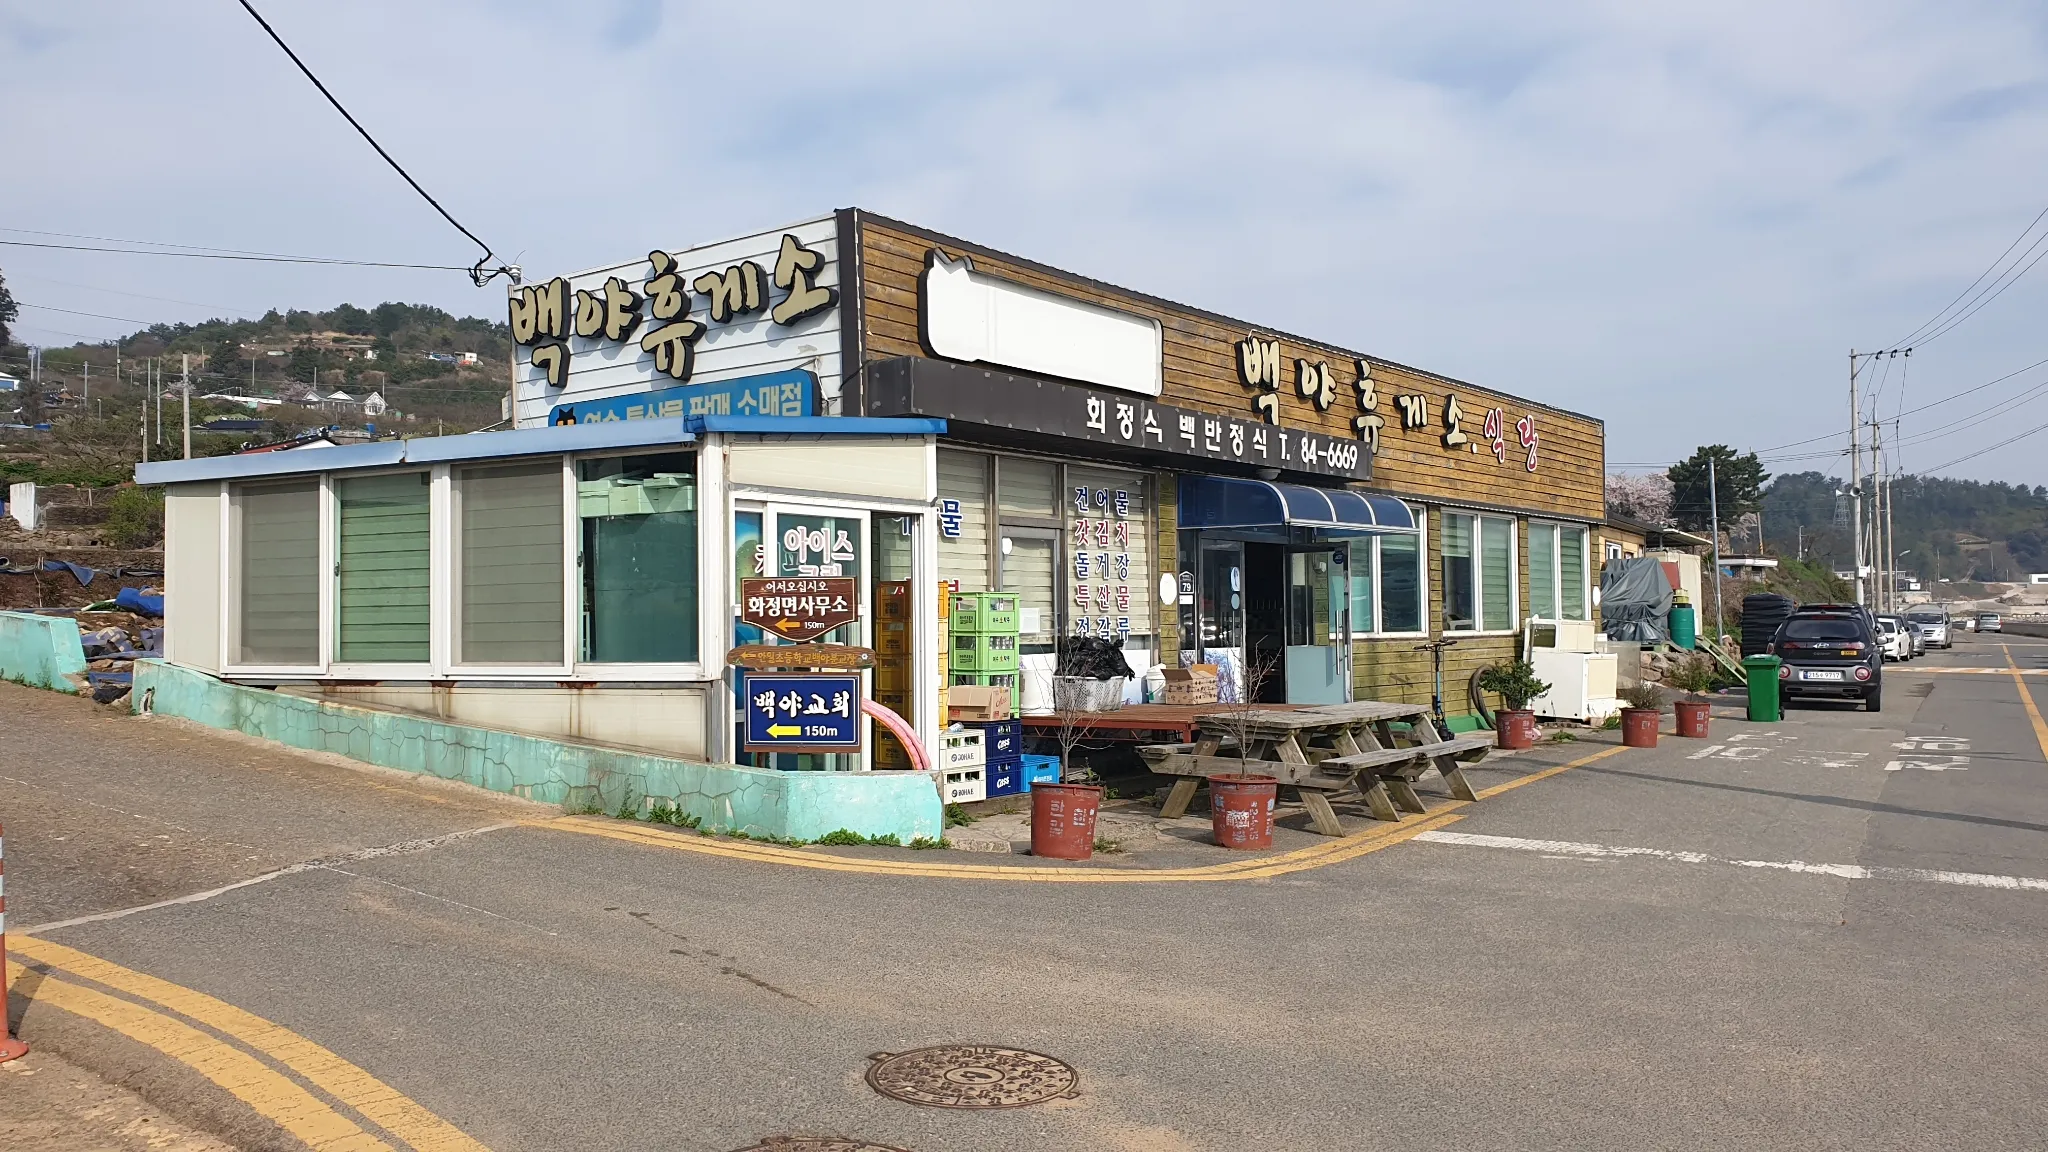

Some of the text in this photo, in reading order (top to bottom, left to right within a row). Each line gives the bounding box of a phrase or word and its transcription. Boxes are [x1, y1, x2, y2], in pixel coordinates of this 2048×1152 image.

[510, 234, 839, 388] 백야휴게소
[1086, 396, 1358, 470] 회정식 백반정식 T. 84-6669
[1484, 407, 1538, 472] 식당
[1074, 485, 1130, 516] 건어물
[784, 526, 855, 564] 아이스
[1074, 519, 1130, 548] 갓김치
[1074, 552, 1131, 580] 돌게장
[765, 580, 829, 593] 어서오십시오
[1074, 584, 1131, 612] 특산물
[1181, 583, 1191, 592] 79
[748, 596, 849, 617] 화정면사무소
[804, 621, 825, 630] 150m
[753, 690, 851, 719] 백야교회
[804, 725, 838, 737] 150m
